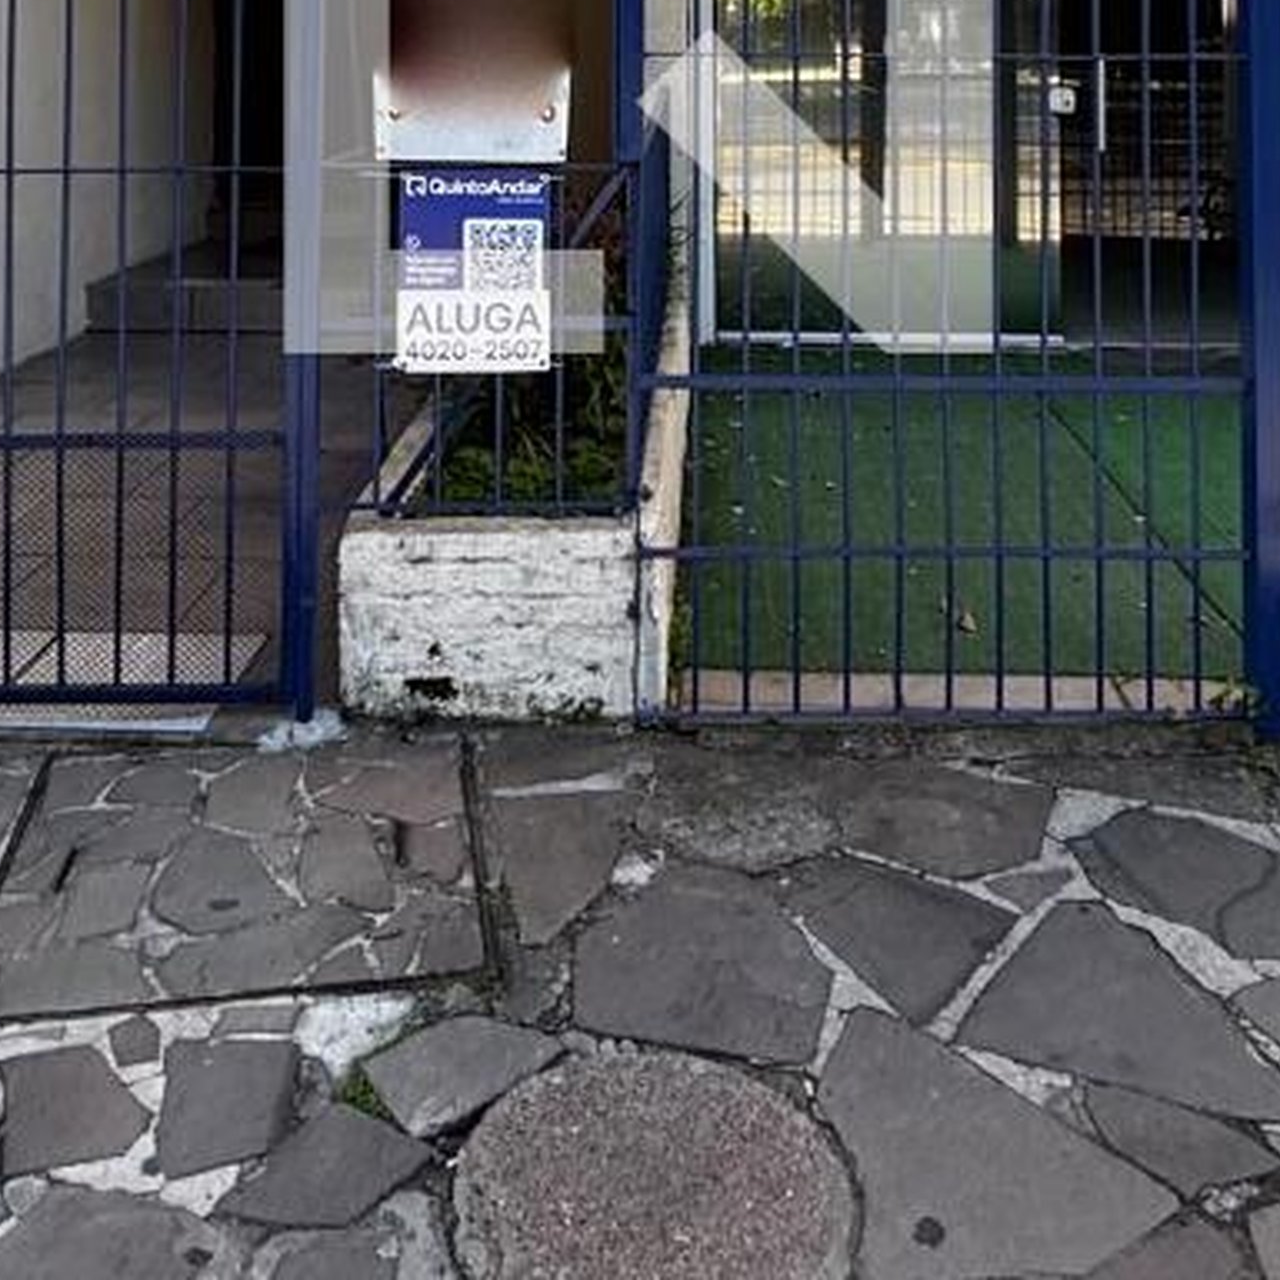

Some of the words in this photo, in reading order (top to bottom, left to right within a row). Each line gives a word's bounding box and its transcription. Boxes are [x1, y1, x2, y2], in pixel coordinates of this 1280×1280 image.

[428, 177, 543, 196] QuintoAndar
[406, 302, 542, 334] ALUGA
[406, 339, 543, 362] 4020-2507
